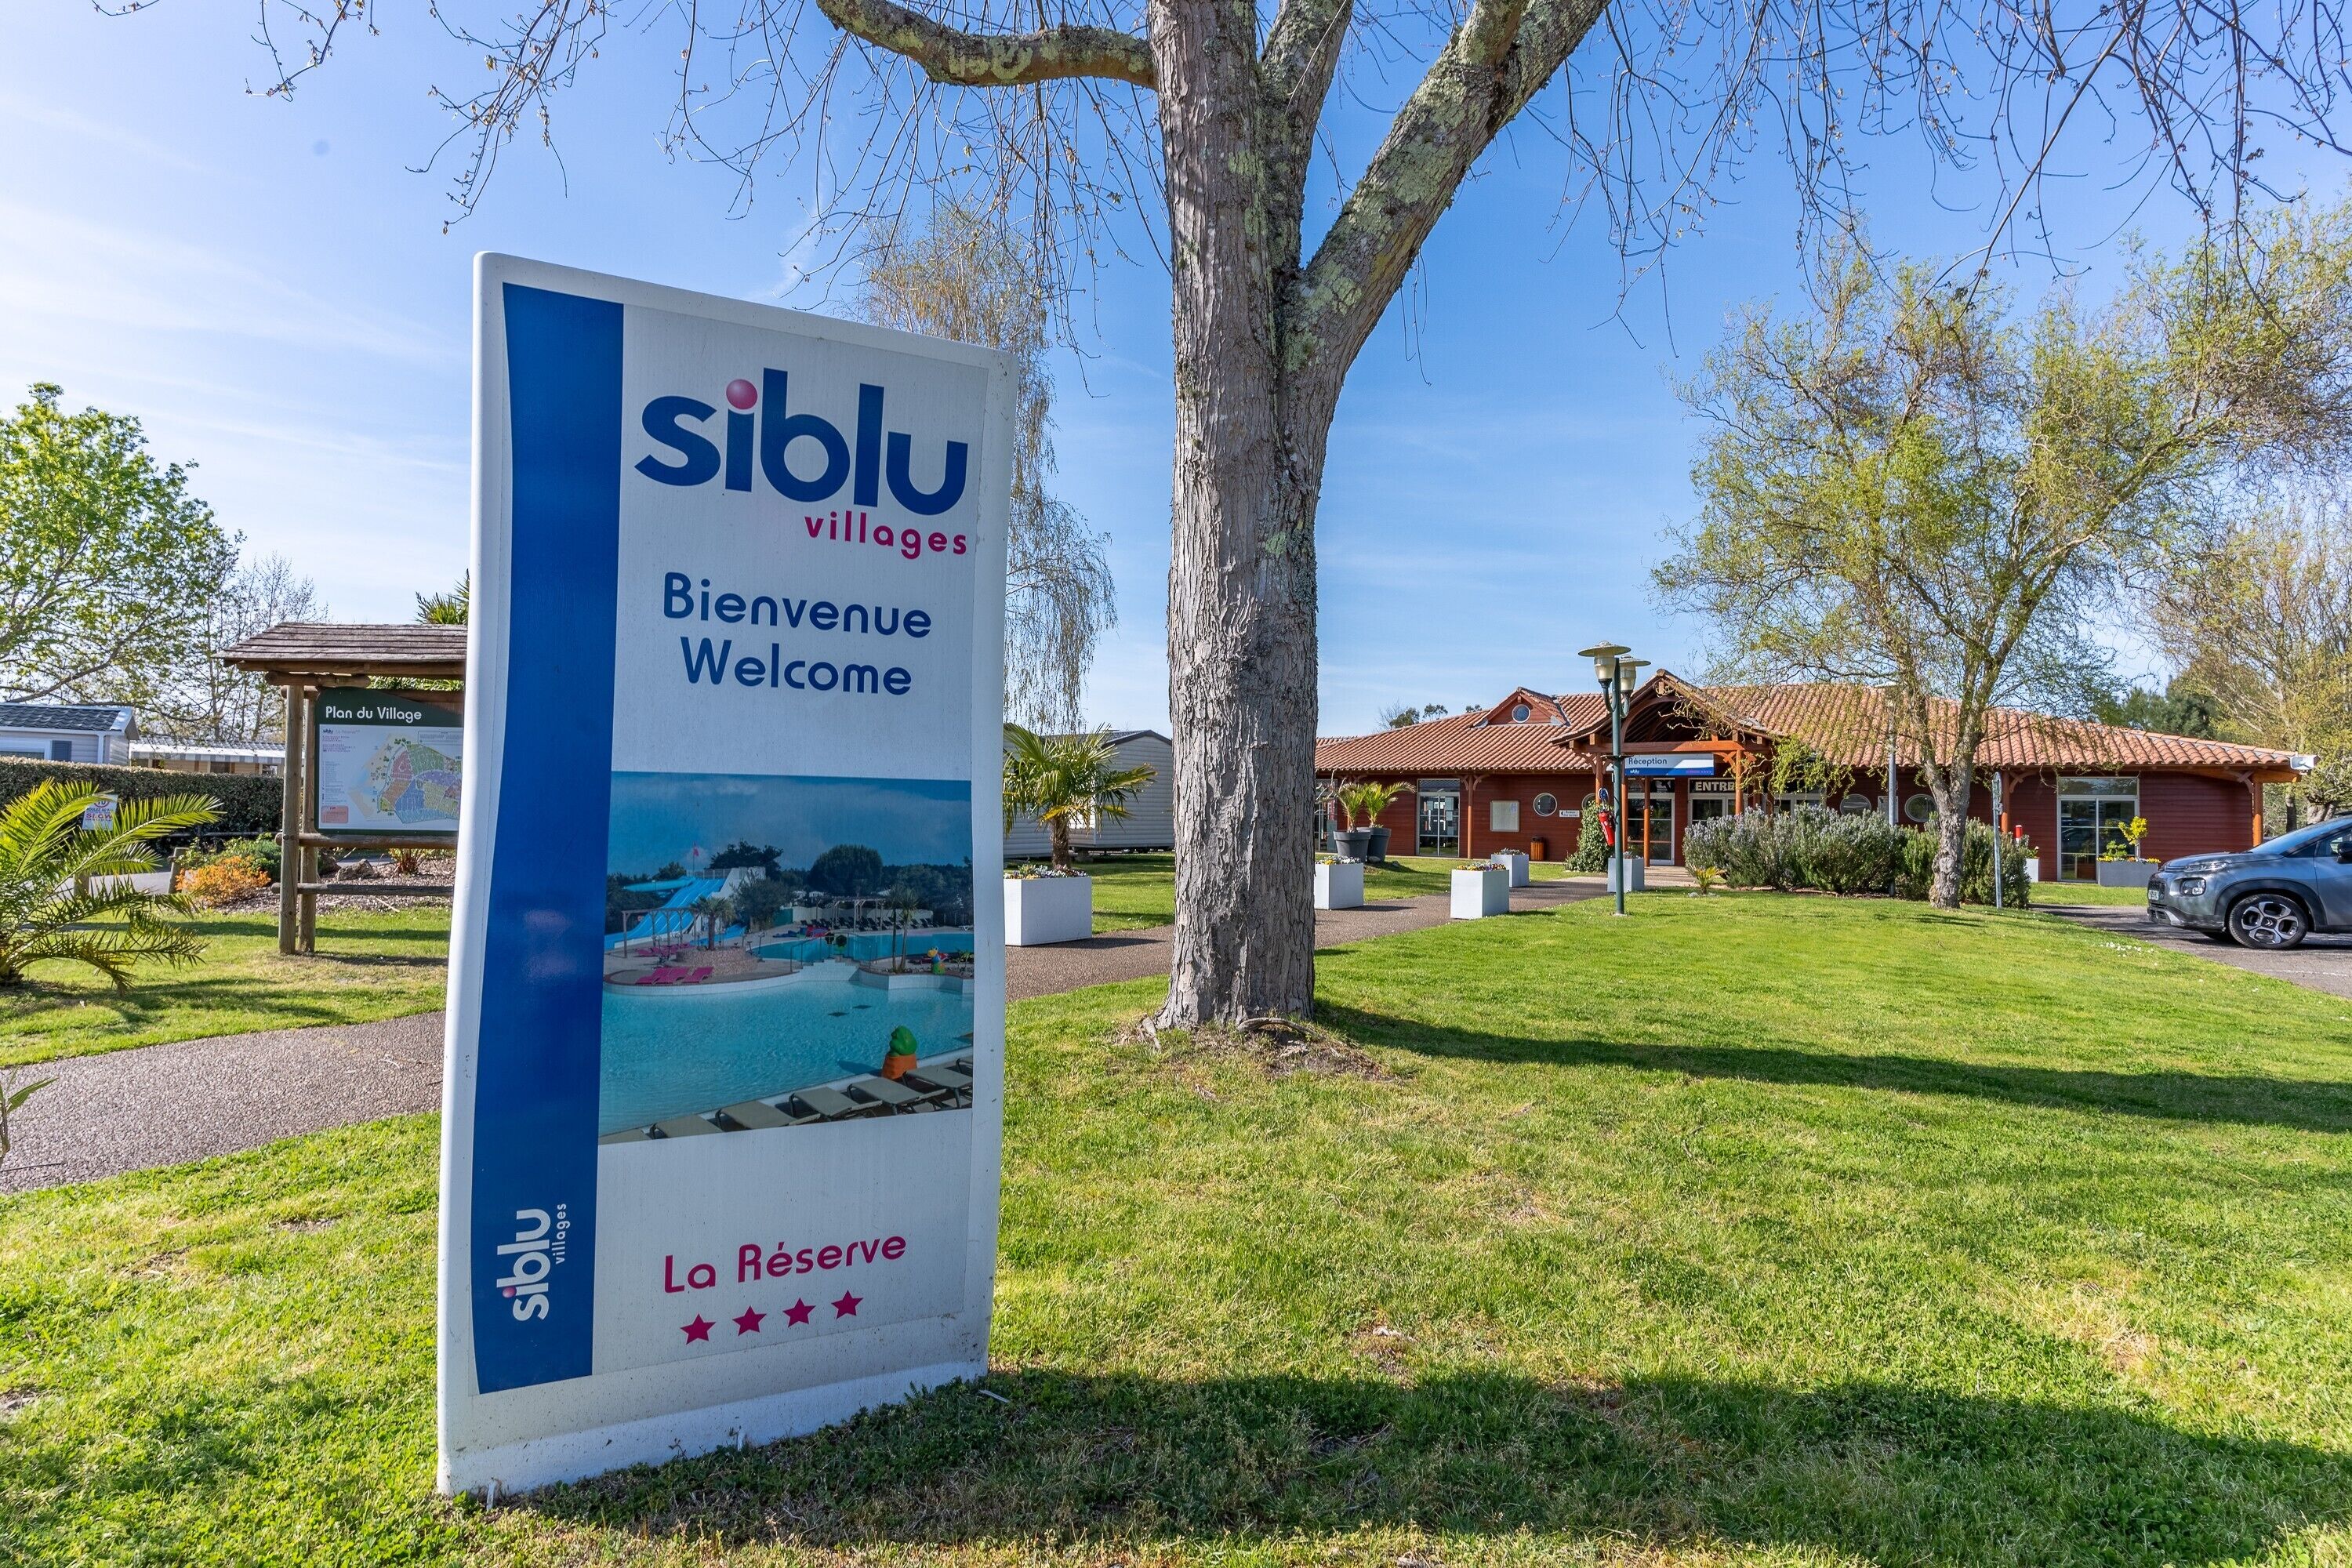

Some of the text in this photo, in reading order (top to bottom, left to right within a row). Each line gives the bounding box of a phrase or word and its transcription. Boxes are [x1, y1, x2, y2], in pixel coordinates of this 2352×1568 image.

[634, 368, 968, 516] siblu
[804, 510, 967, 560] villages
[663, 572, 931, 638] Bienvenue
[681, 637, 912, 695] Welcome
[325, 706, 422, 723] Plan du Village
[1628, 757, 1668, 767] Réception
[1695, 781, 1735, 791] ENTRE
[552, 1203, 571, 1265] villages
[496, 1208, 551, 1321] siblu
[664, 1236, 906, 1294] La Réserve
